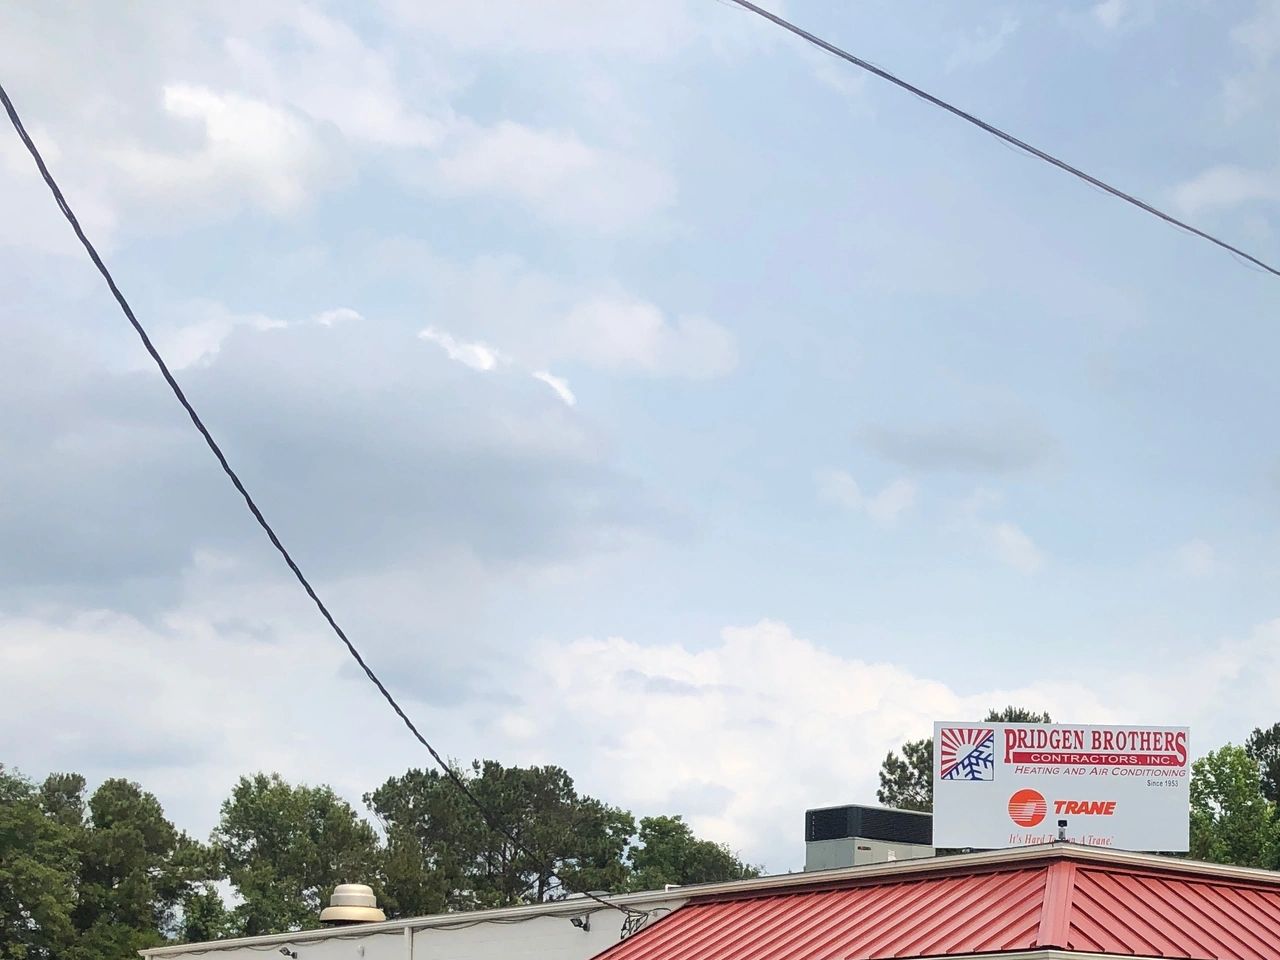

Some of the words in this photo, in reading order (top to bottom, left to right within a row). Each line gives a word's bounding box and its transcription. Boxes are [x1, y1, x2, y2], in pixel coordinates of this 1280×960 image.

[1004, 729, 1085, 764] PRIDGEN
[1091, 730, 1187, 767] BROTHERS
[1146, 756, 1175, 765] INC.
[1014, 765, 1060, 775] HEATING
[1063, 767, 1087, 776] AND
[1089, 767, 1109, 776] AIR
[1111, 767, 1187, 777] CONDITIONING
[1146, 779, 1163, 787] Since
[1053, 800, 1117, 816] TRANE
